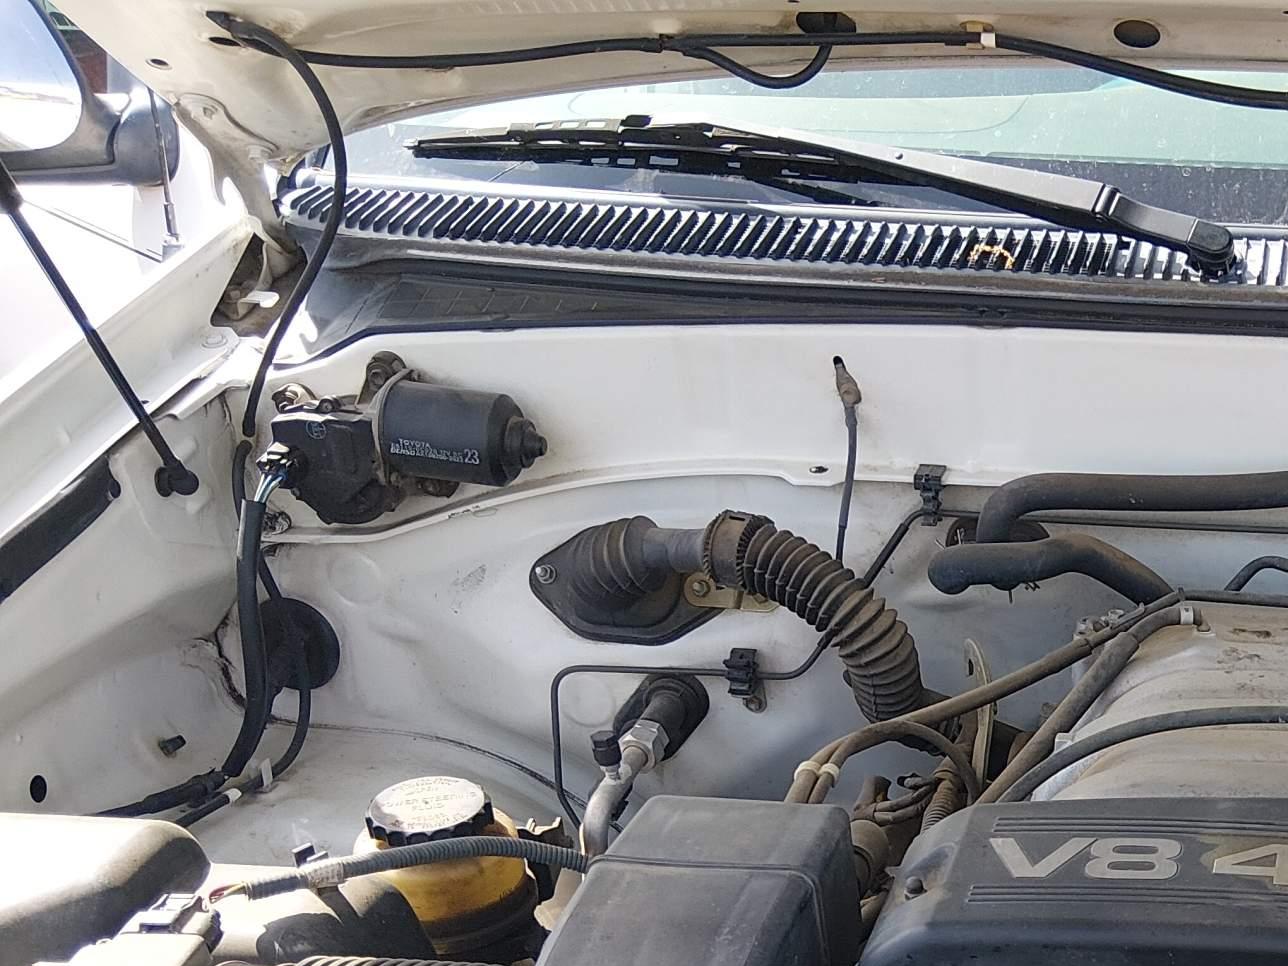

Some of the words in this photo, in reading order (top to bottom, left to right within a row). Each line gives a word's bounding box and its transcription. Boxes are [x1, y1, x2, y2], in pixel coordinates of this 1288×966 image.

[398, 438, 432, 451] TOYOTA
[463, 449, 480, 465] 23
[989, 837, 1183, 881] V8
